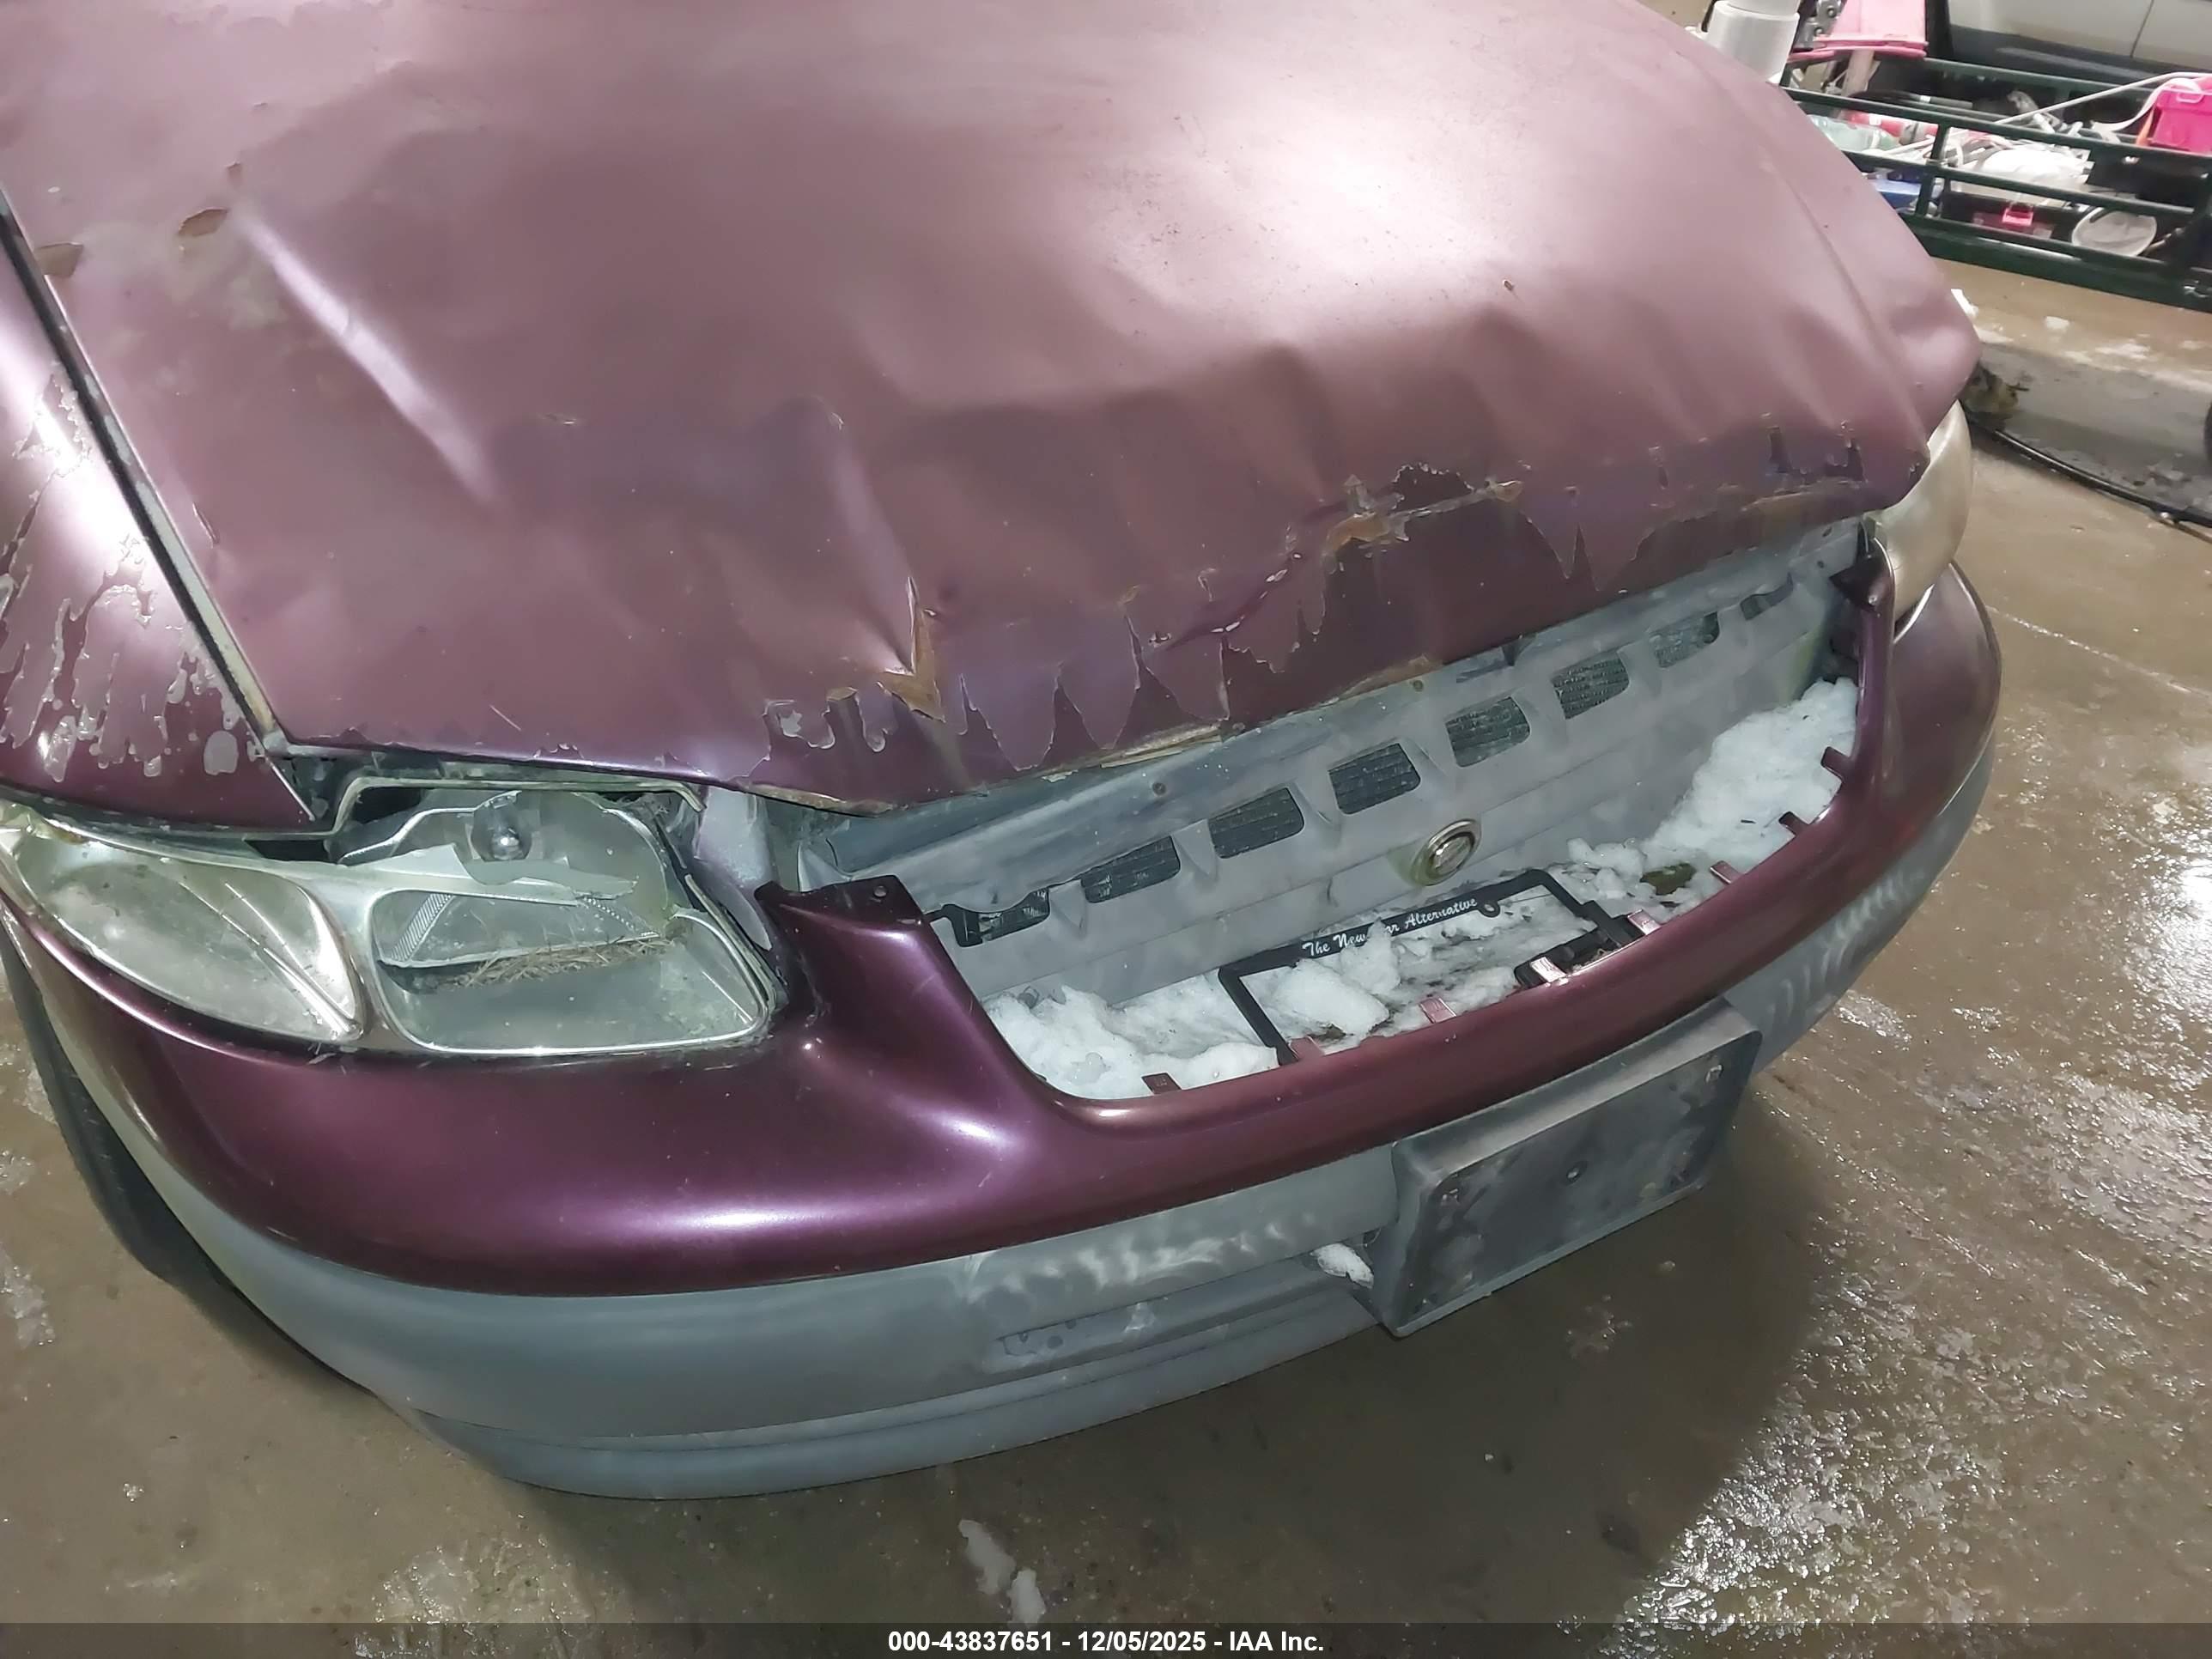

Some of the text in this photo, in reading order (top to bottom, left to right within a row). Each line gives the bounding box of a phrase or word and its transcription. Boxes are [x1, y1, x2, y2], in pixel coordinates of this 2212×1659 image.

[1302, 941, 1331, 957] The
[1333, 933, 1366, 948] New
[1404, 898, 1478, 929] Alternative
